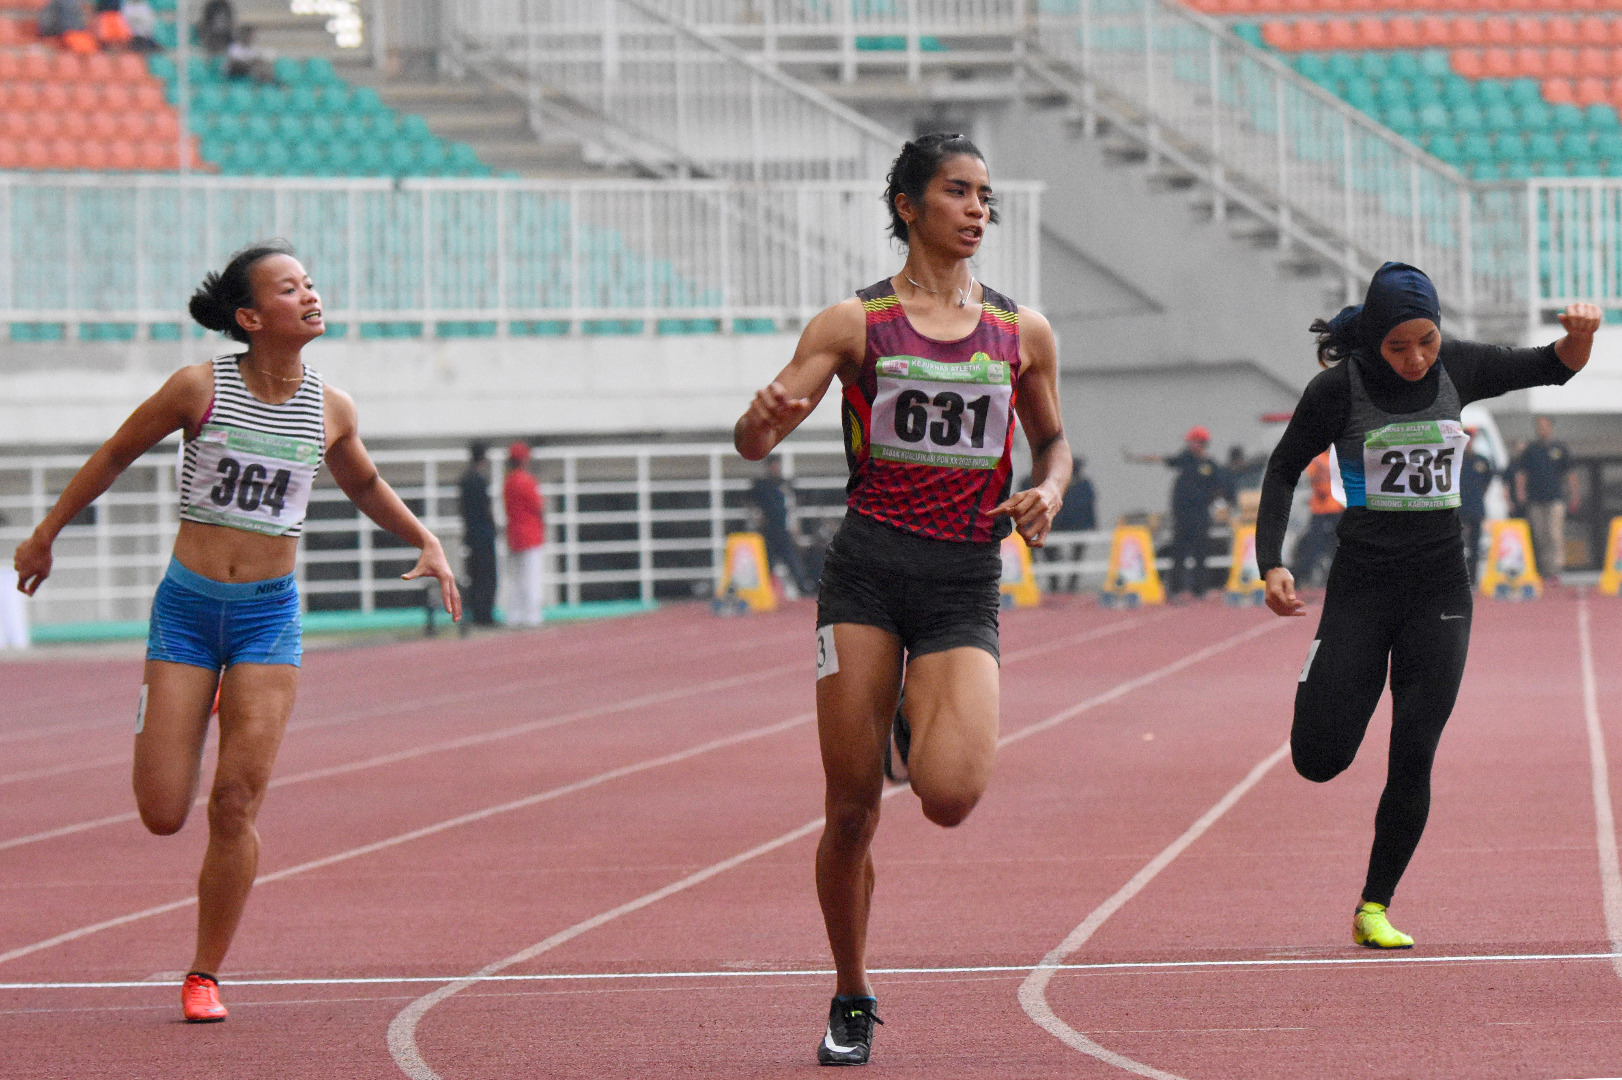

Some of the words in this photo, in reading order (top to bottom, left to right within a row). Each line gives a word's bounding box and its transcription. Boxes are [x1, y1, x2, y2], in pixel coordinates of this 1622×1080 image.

[951, 363, 981, 372] ATLETIK
[894, 389, 991, 449] 631
[211, 457, 291, 518] 364
[1381, 447, 1455, 495] 235
[255, 580, 286, 596] NIKE
